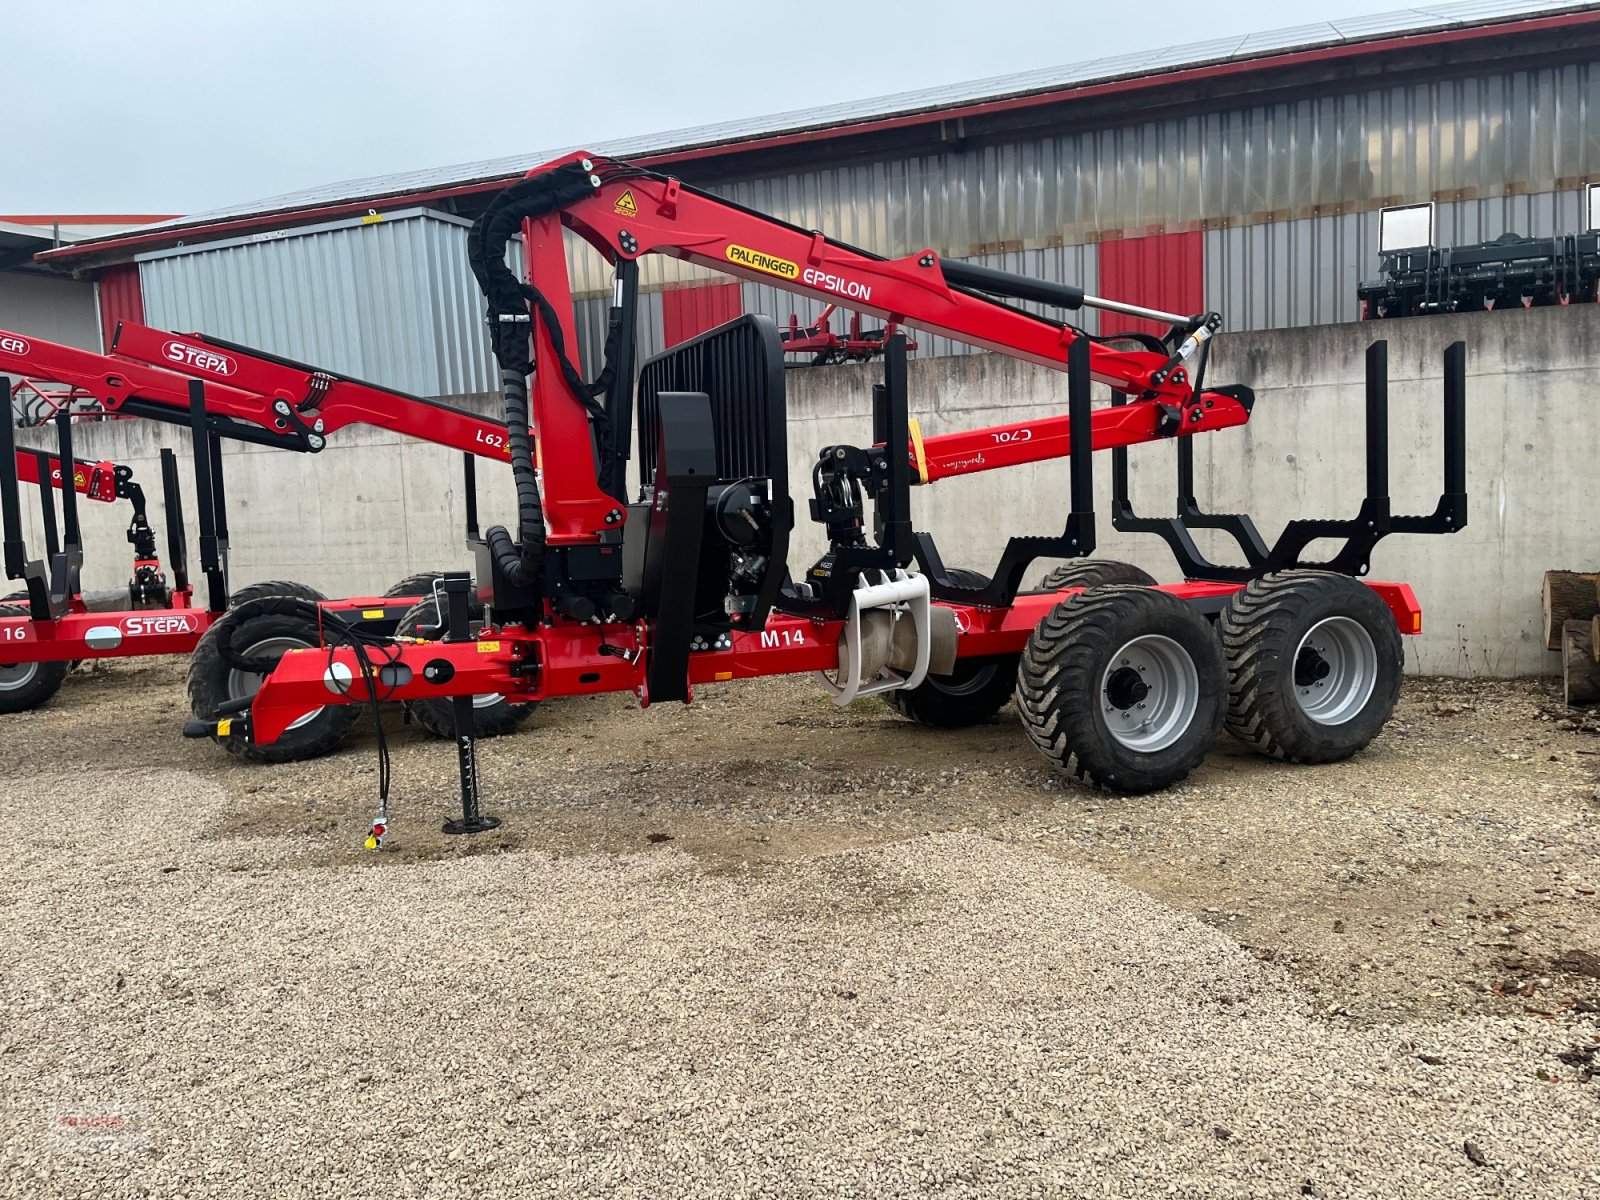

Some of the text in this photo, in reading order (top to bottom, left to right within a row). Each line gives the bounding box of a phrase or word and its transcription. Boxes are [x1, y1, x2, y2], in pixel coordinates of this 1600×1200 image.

[730, 247, 871, 301] PALFINGER EPSILON
[0, 336, 24, 353] ER
[168, 342, 228, 374] STEPA
[476, 429, 503, 448] L62
[990, 428, 1032, 443] C70L
[126, 617, 191, 635] STEPA
[760, 629, 805, 648] M14
